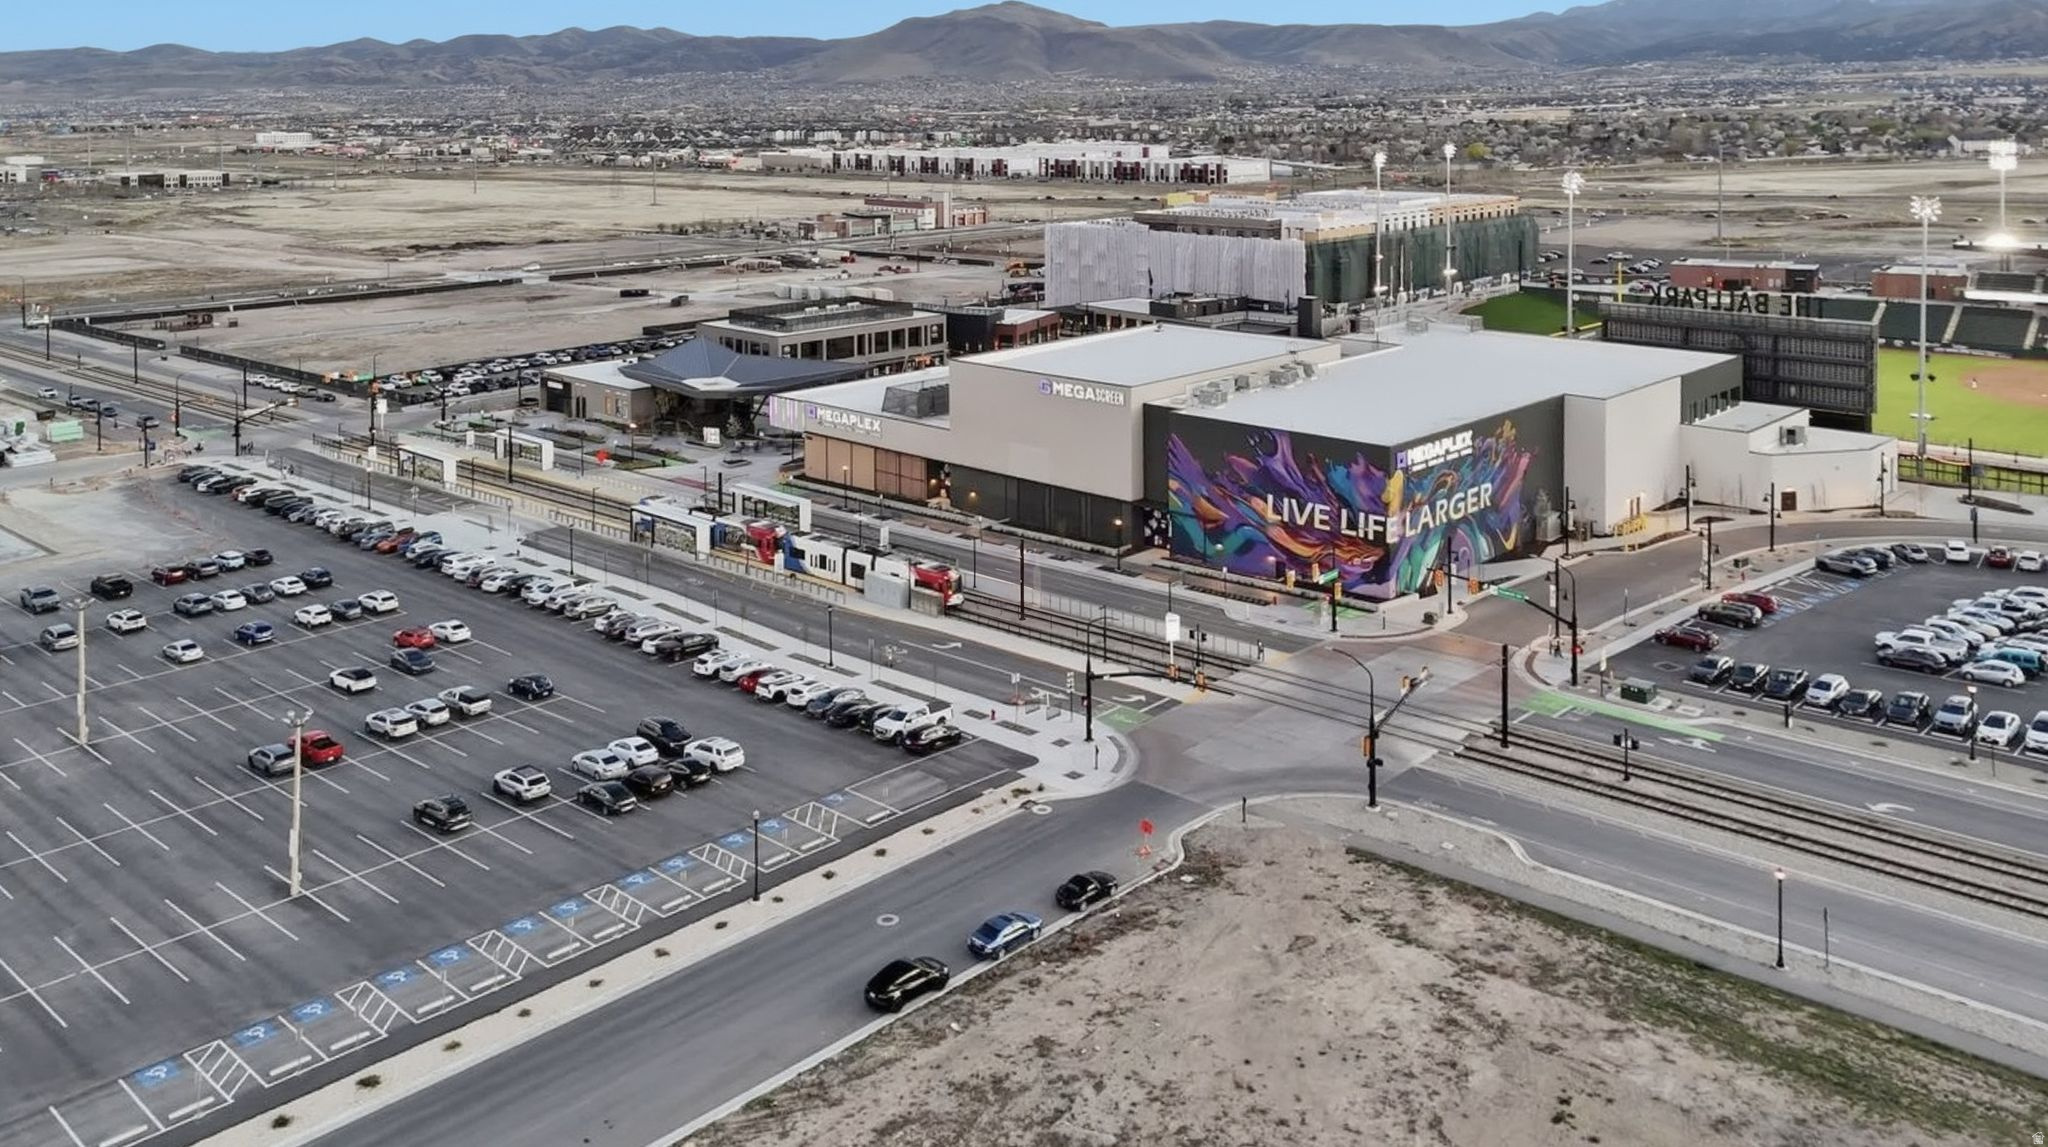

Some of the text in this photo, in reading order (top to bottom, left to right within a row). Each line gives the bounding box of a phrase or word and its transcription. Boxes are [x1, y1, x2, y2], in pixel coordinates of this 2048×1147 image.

[817, 407, 881, 432] MEGAPLEX
[1266, 483, 1493, 545] LIVE LIFE LARGER
